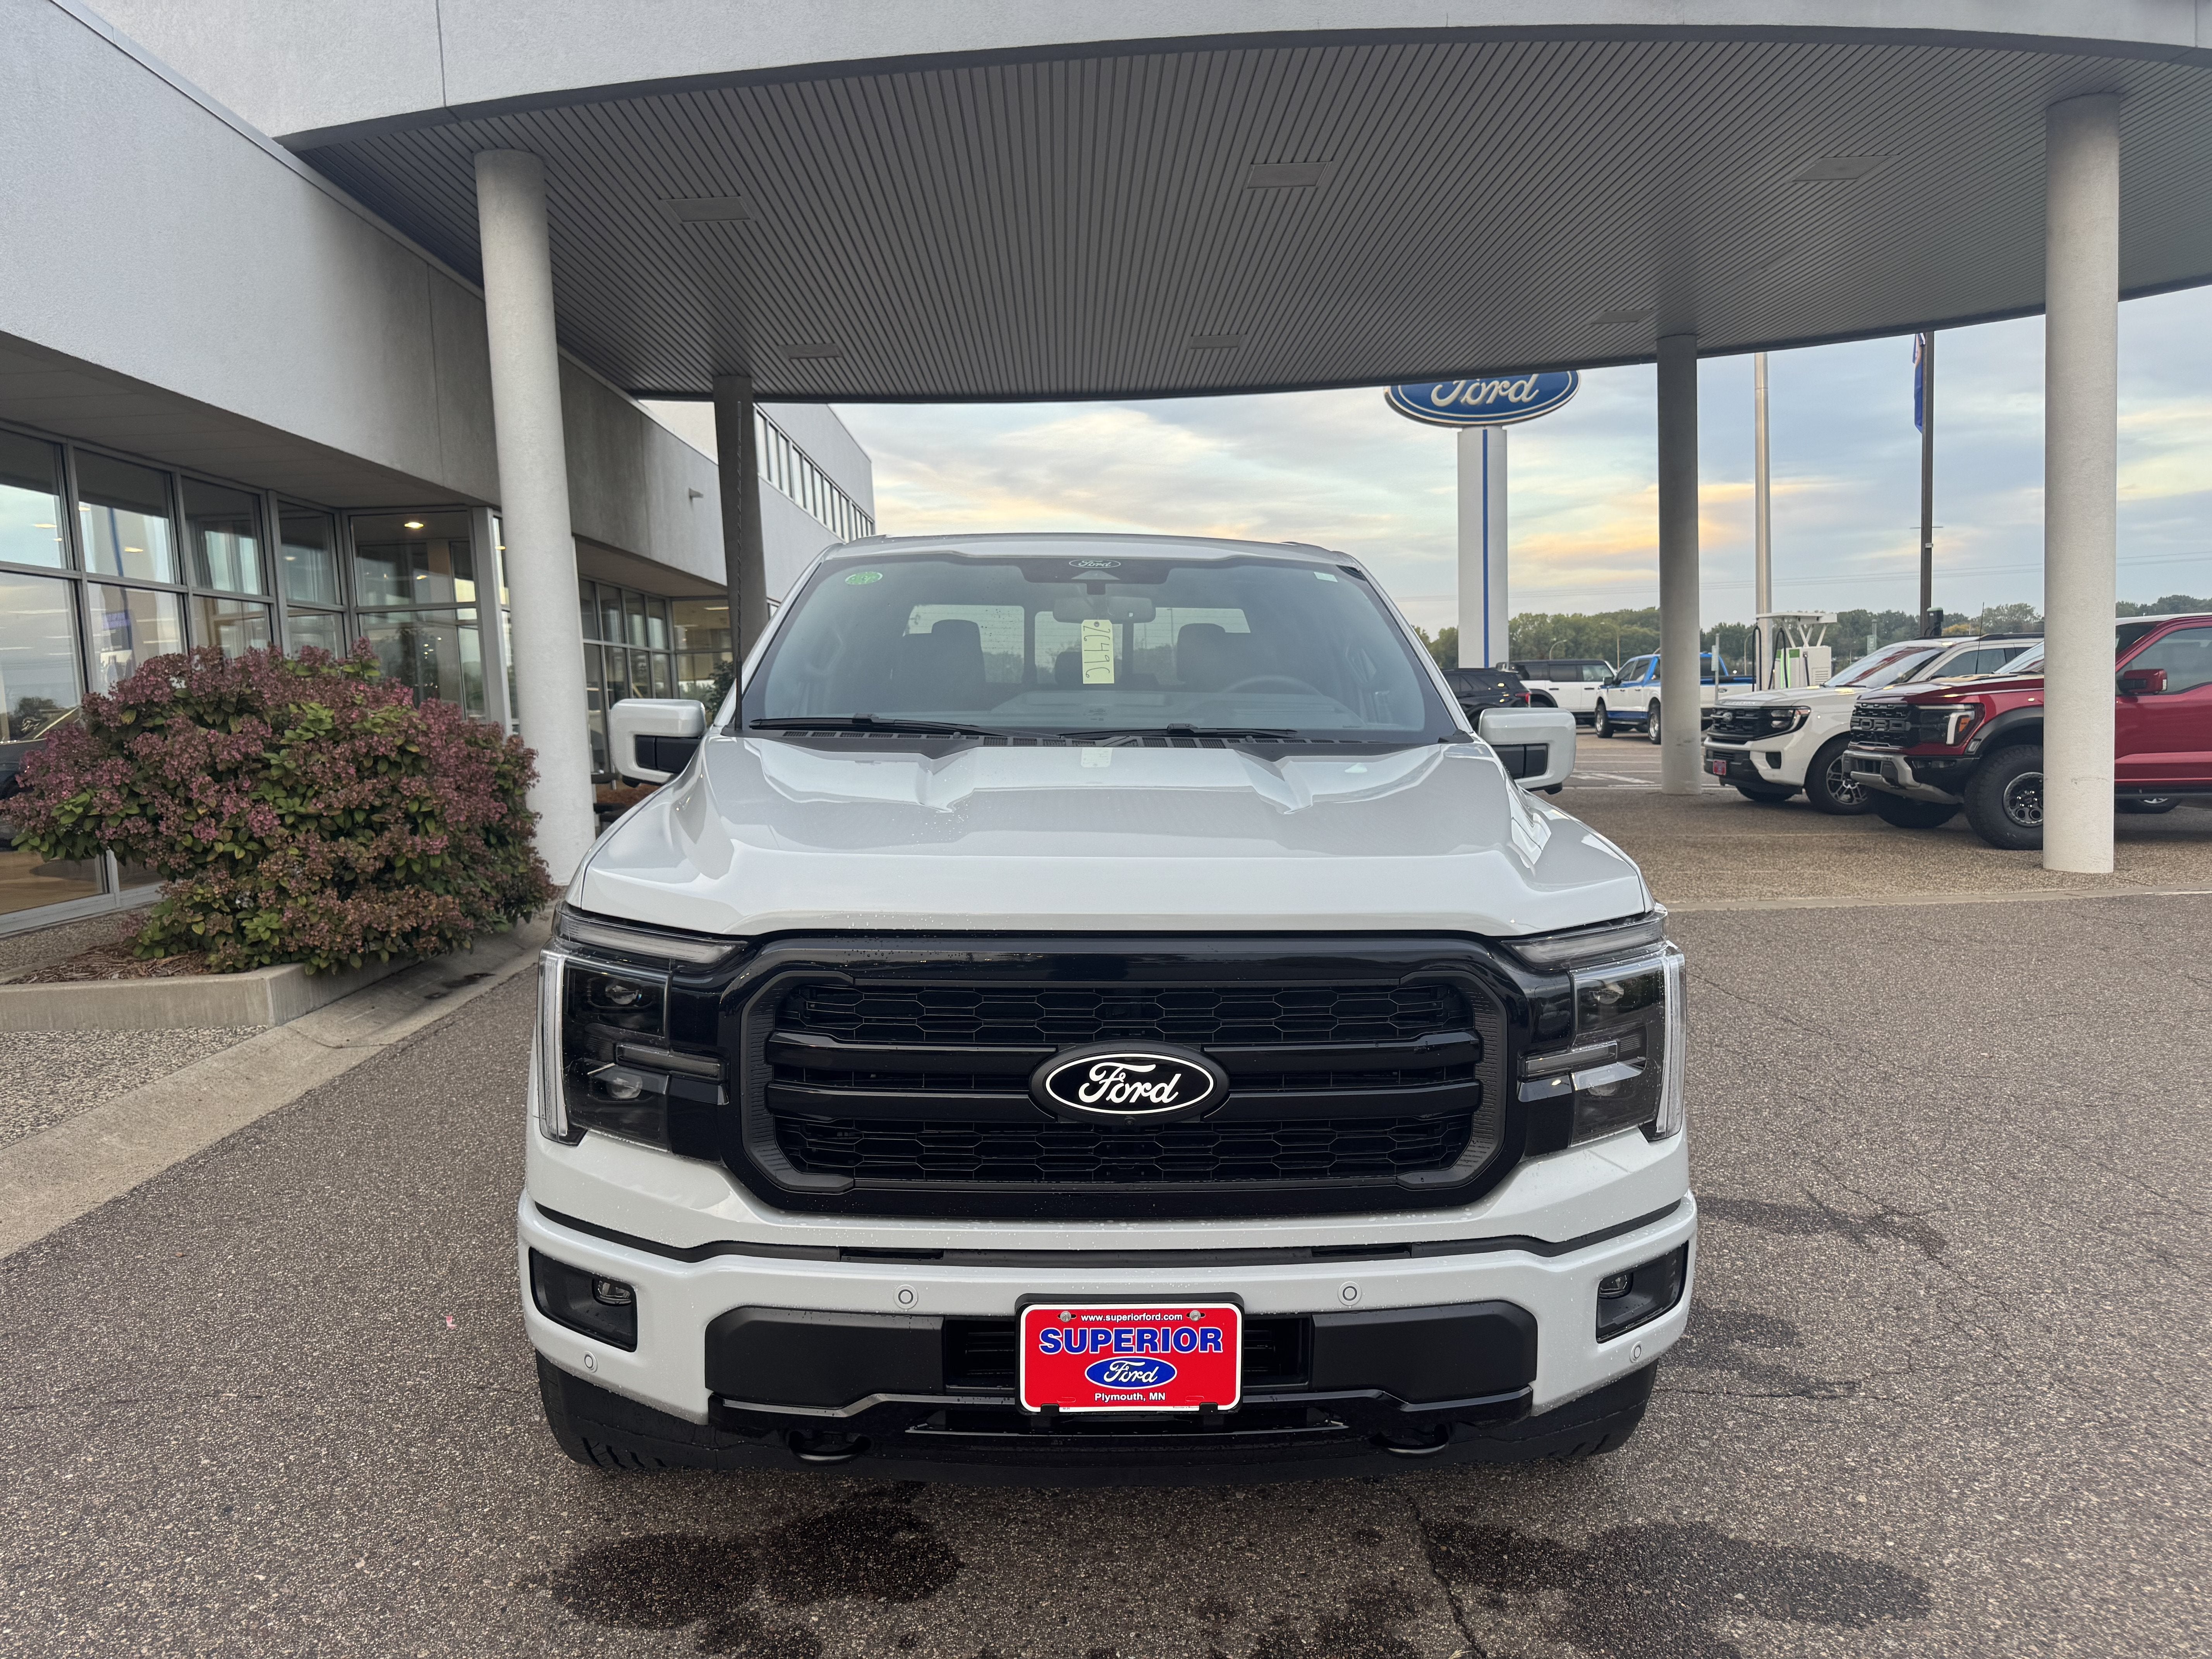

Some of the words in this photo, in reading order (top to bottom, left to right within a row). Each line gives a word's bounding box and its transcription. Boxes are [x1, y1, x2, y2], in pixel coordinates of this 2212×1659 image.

[1079, 1062, 1182, 1103] Ford
[1081, 1312, 1183, 1323] www.superiorford.com
[1039, 1326, 1223, 1355] SUPERIOR
[1103, 1360, 1158, 1383] Ford
[1095, 1393, 1146, 1403] Plymouth,
[1149, 1393, 1166, 1401] MN
